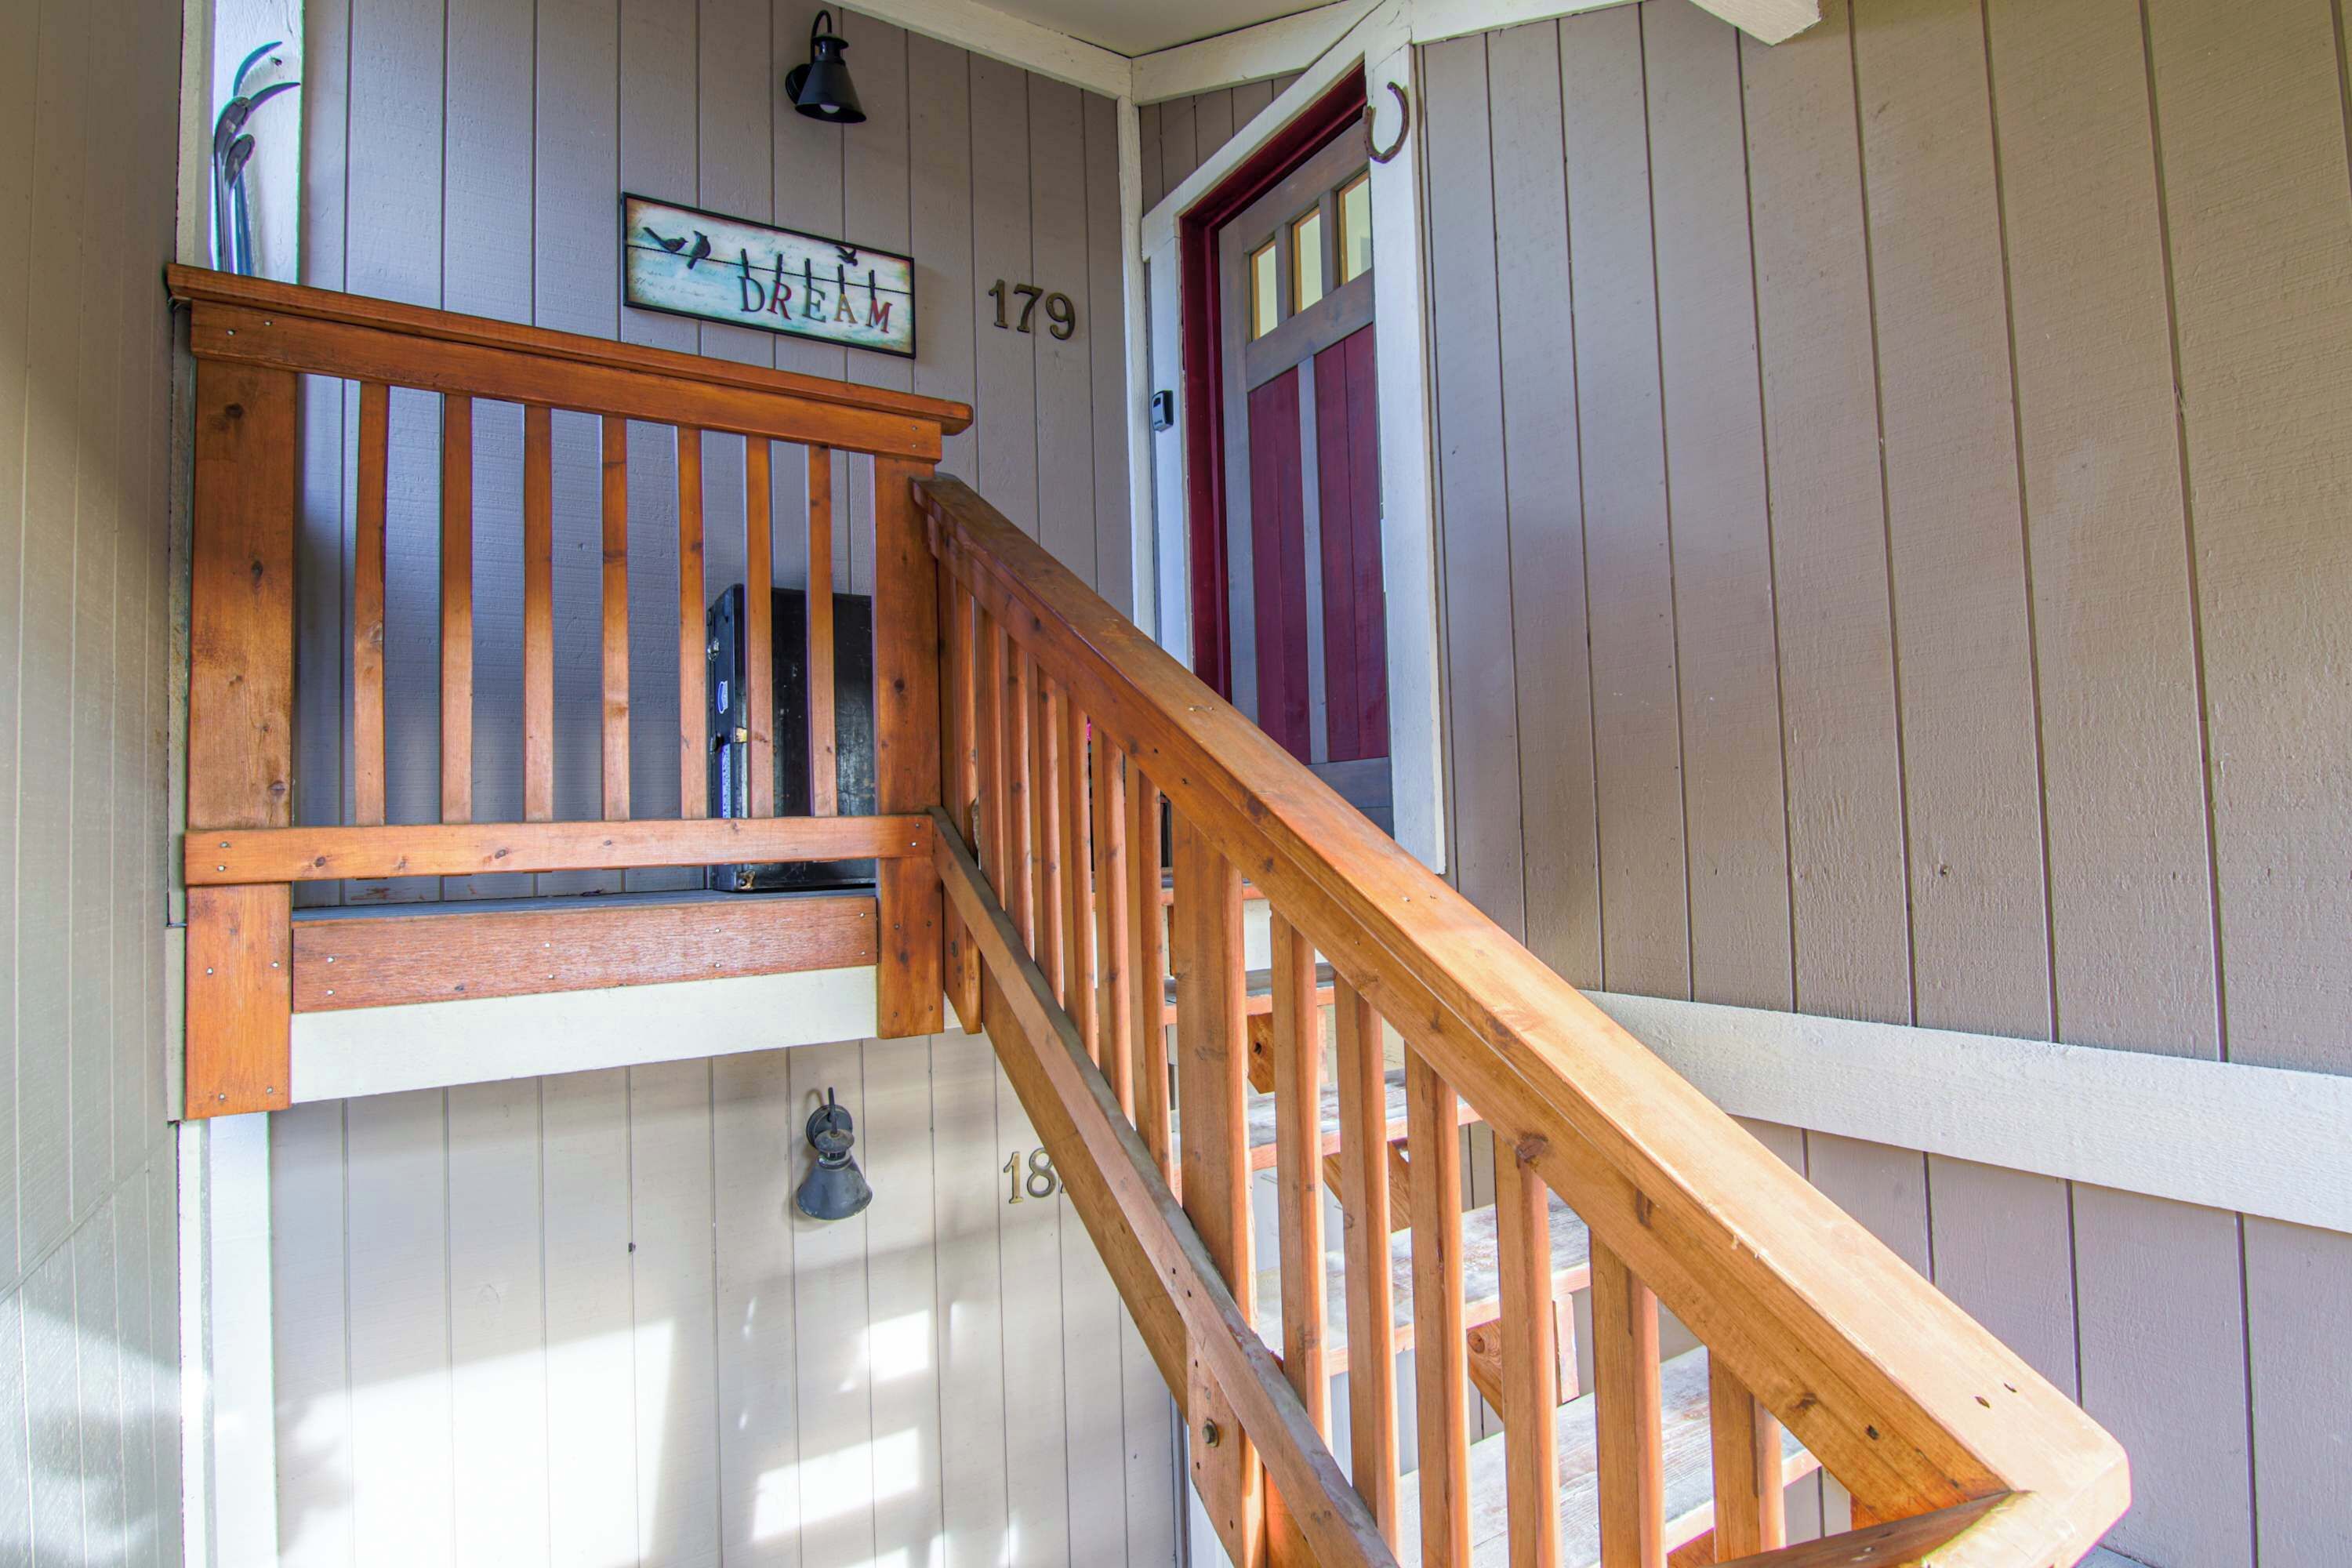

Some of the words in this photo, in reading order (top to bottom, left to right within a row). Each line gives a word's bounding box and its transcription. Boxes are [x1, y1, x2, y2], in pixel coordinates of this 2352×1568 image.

[739, 275, 892, 333] DREAM
[989, 279, 1076, 339] 179
[1004, 1147, 1068, 1204] 18
